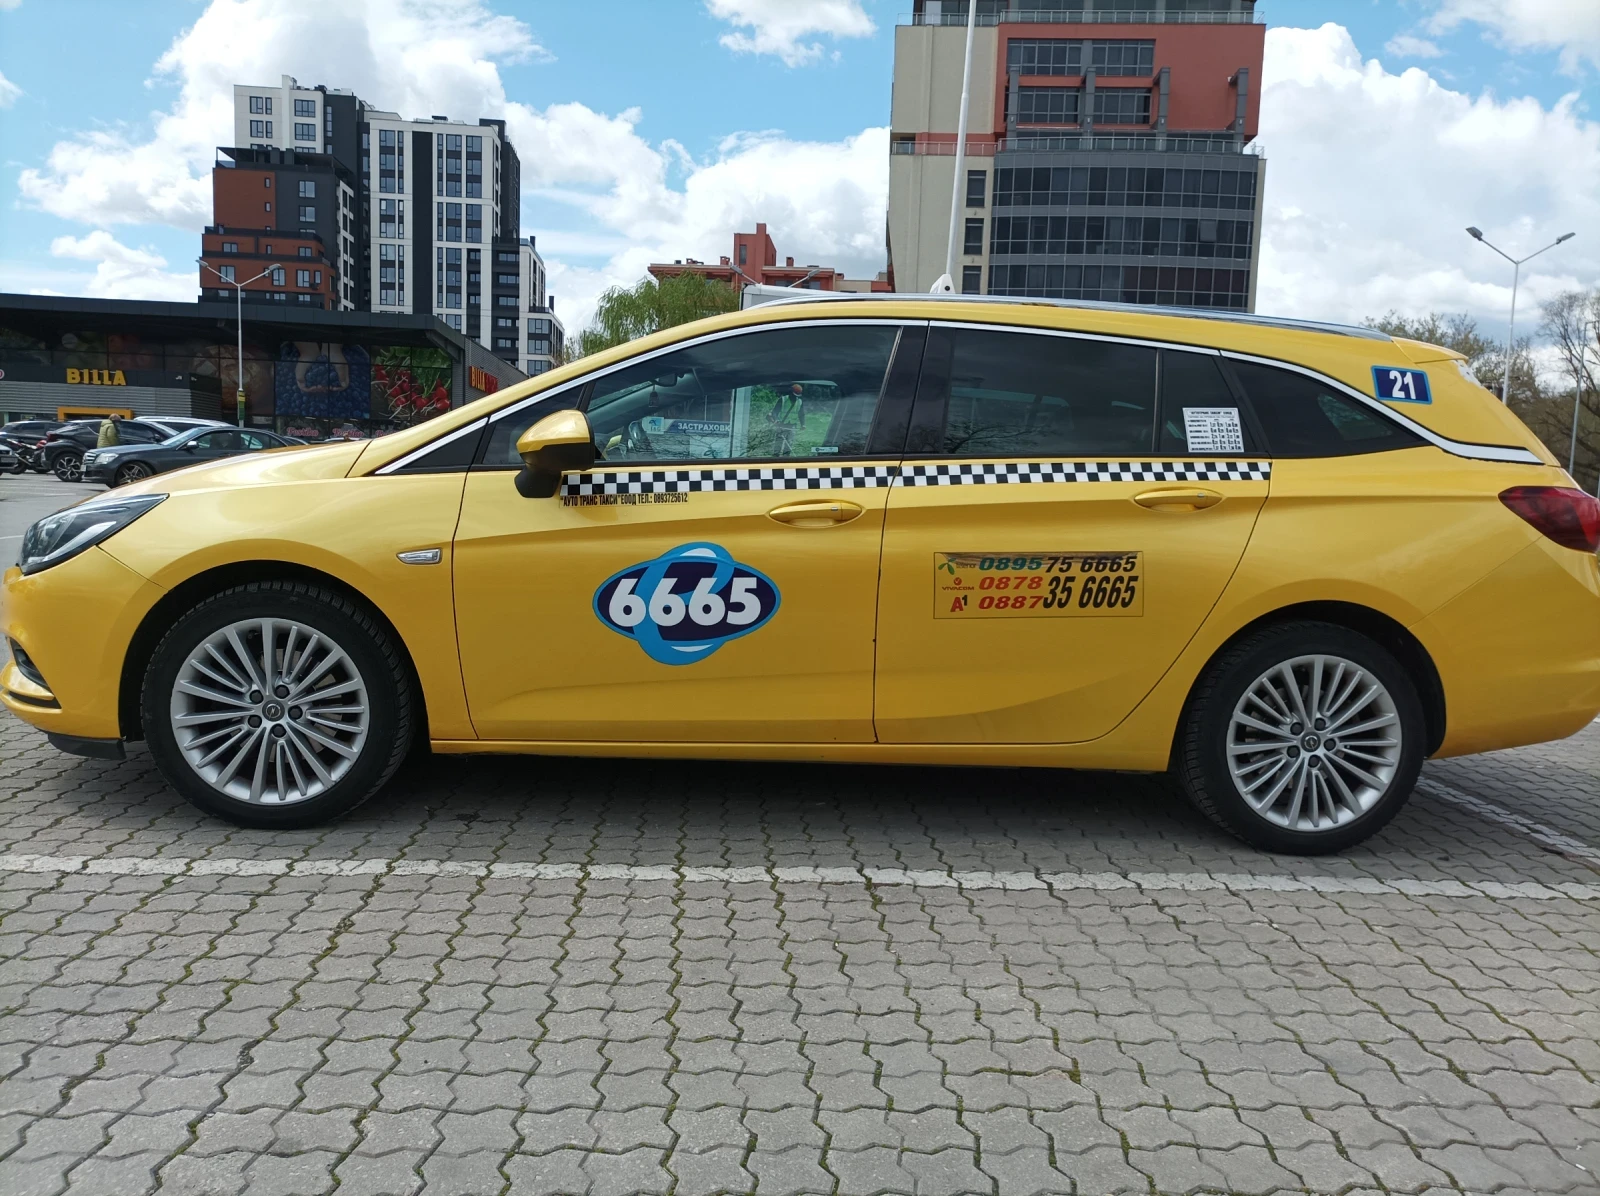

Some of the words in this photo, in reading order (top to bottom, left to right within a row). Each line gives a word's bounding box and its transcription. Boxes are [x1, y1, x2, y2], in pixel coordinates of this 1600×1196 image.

[66, 368, 126, 386] BILLA
[1389, 370, 1416, 400] 21
[580, 496, 598, 506] ТРАНС
[653, 492, 688, 504] 0893725612
[979, 557, 1043, 571] 0895
[1045, 557, 1074, 573] 75
[1079, 556, 1138, 573] 6665
[978, 576, 1043, 590] 0878
[1042, 576, 1076, 609] 35
[1078, 576, 1139, 609] 6665
[608, 577, 761, 627] 6665
[950, 595, 968, 612] A1
[978, 596, 1044, 610] 0887
